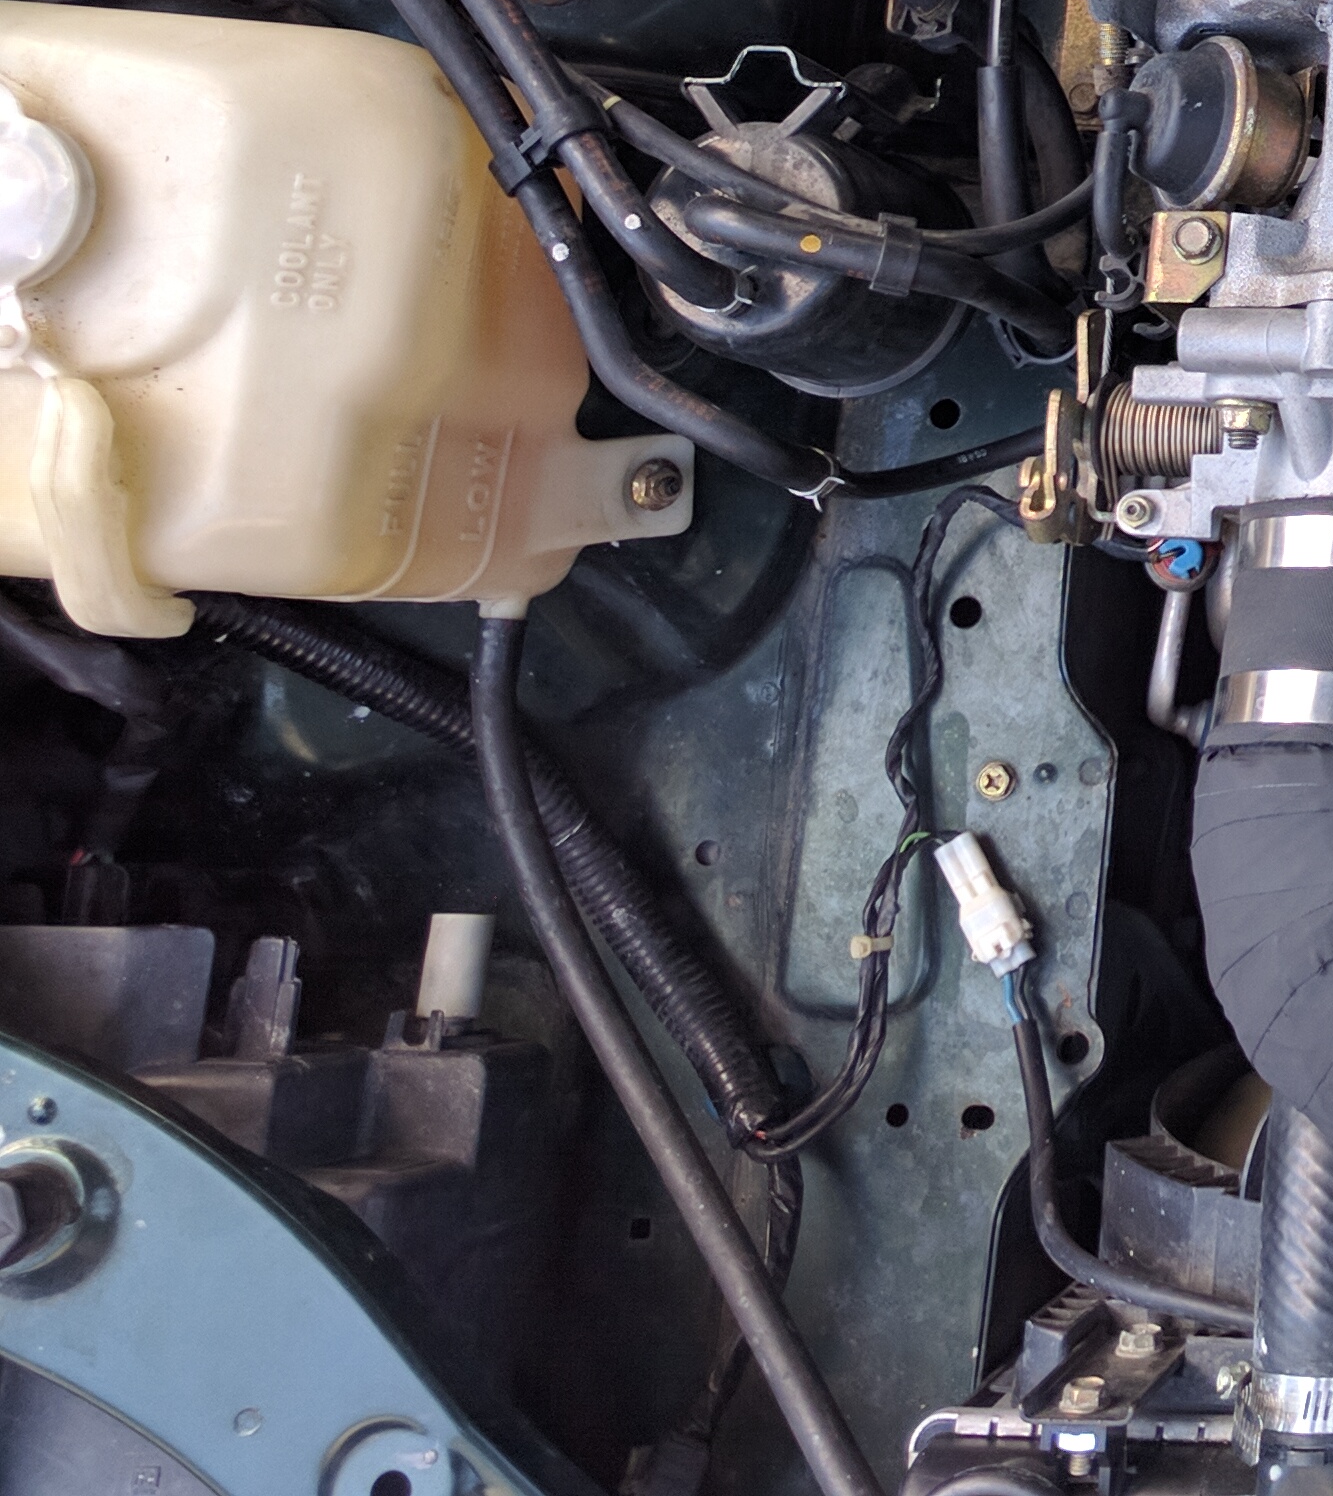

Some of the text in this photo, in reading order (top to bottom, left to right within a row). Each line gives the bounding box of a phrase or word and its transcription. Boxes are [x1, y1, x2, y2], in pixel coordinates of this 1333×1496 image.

[268, 170, 324, 310] COOLANT
[306, 233, 349, 316] ONLY
[377, 425, 422, 540] FULL
[457, 440, 500, 545] LOW
